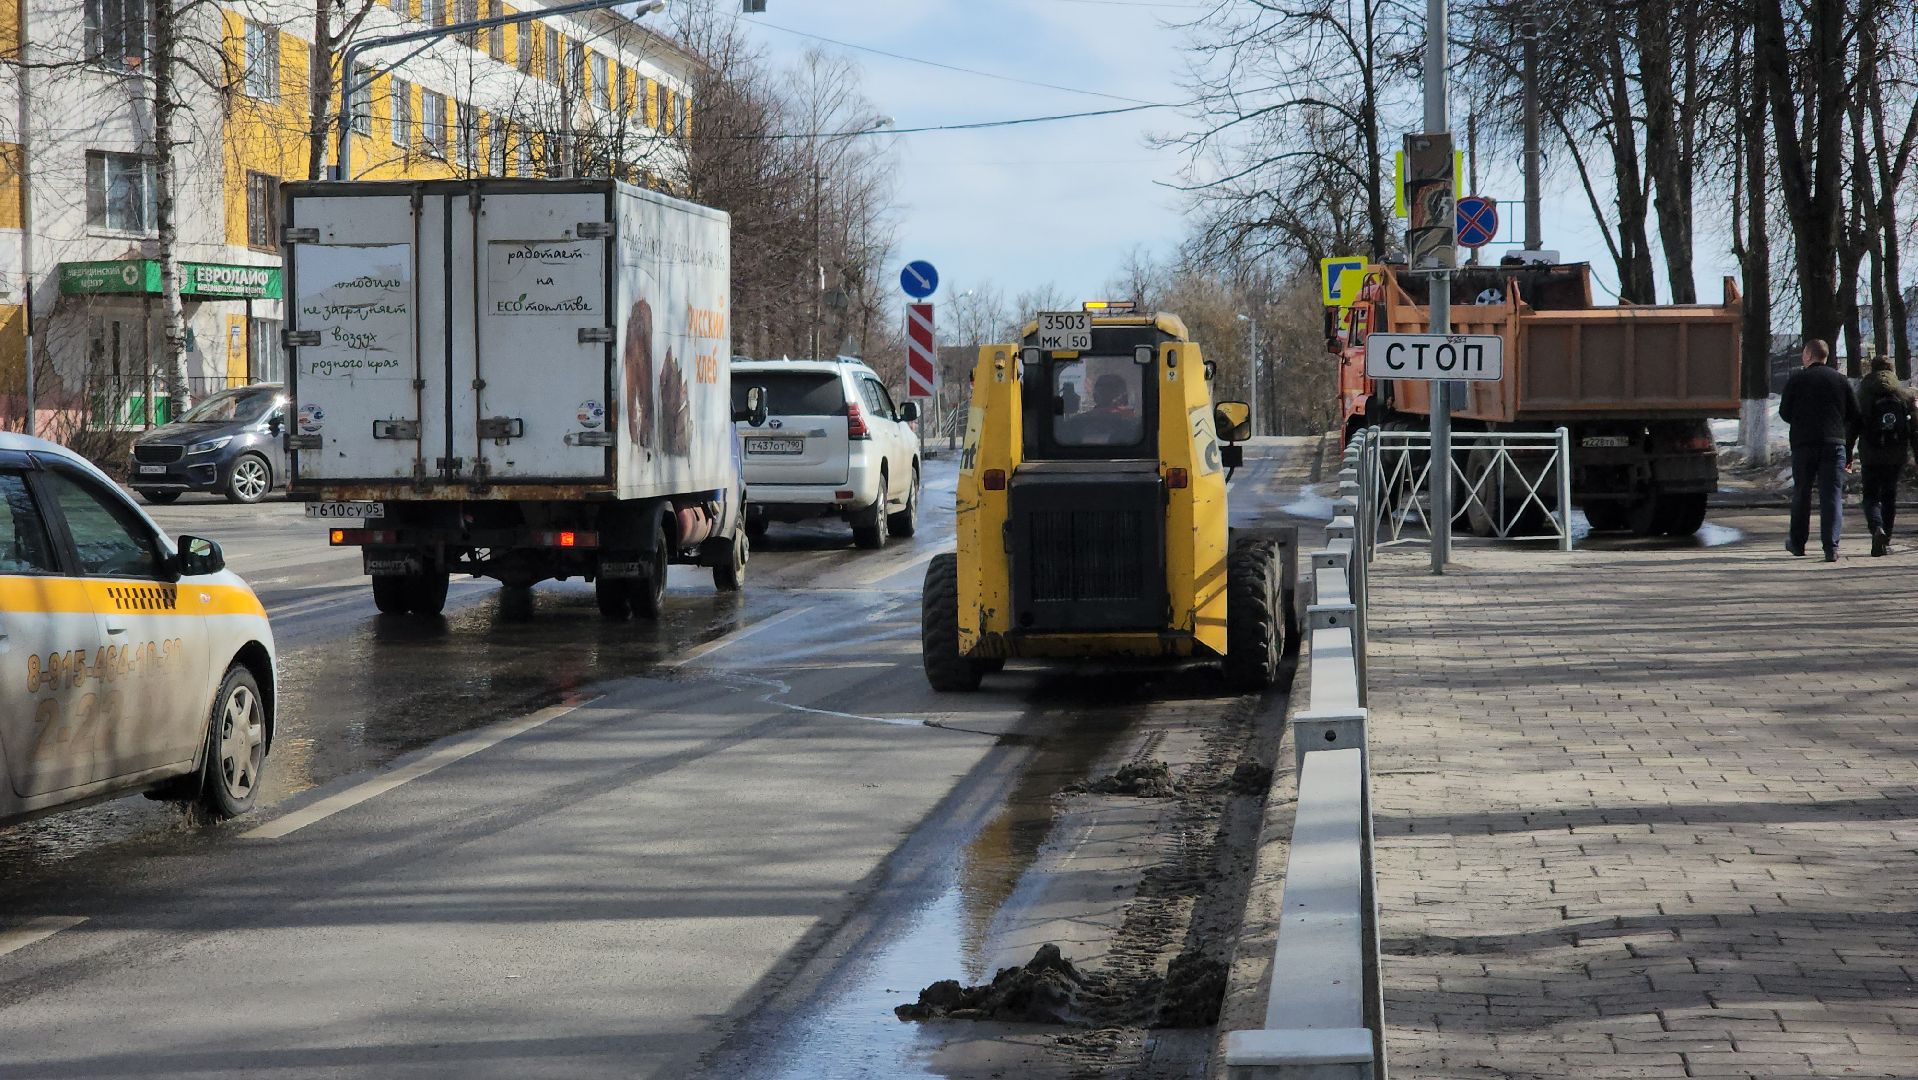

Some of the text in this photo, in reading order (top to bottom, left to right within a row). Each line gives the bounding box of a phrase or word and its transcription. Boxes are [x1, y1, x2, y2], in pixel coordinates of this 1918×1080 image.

[507, 245, 582, 264] работает
[536, 277, 554, 286] на
[303, 305, 320, 315] не
[1044, 315, 1085, 330] 3503
[331, 325, 378, 350] воздух
[1042, 336, 1088, 348] МК 50
[1386, 342, 1483, 371] СТОП
[311, 360, 399, 376] родного края
